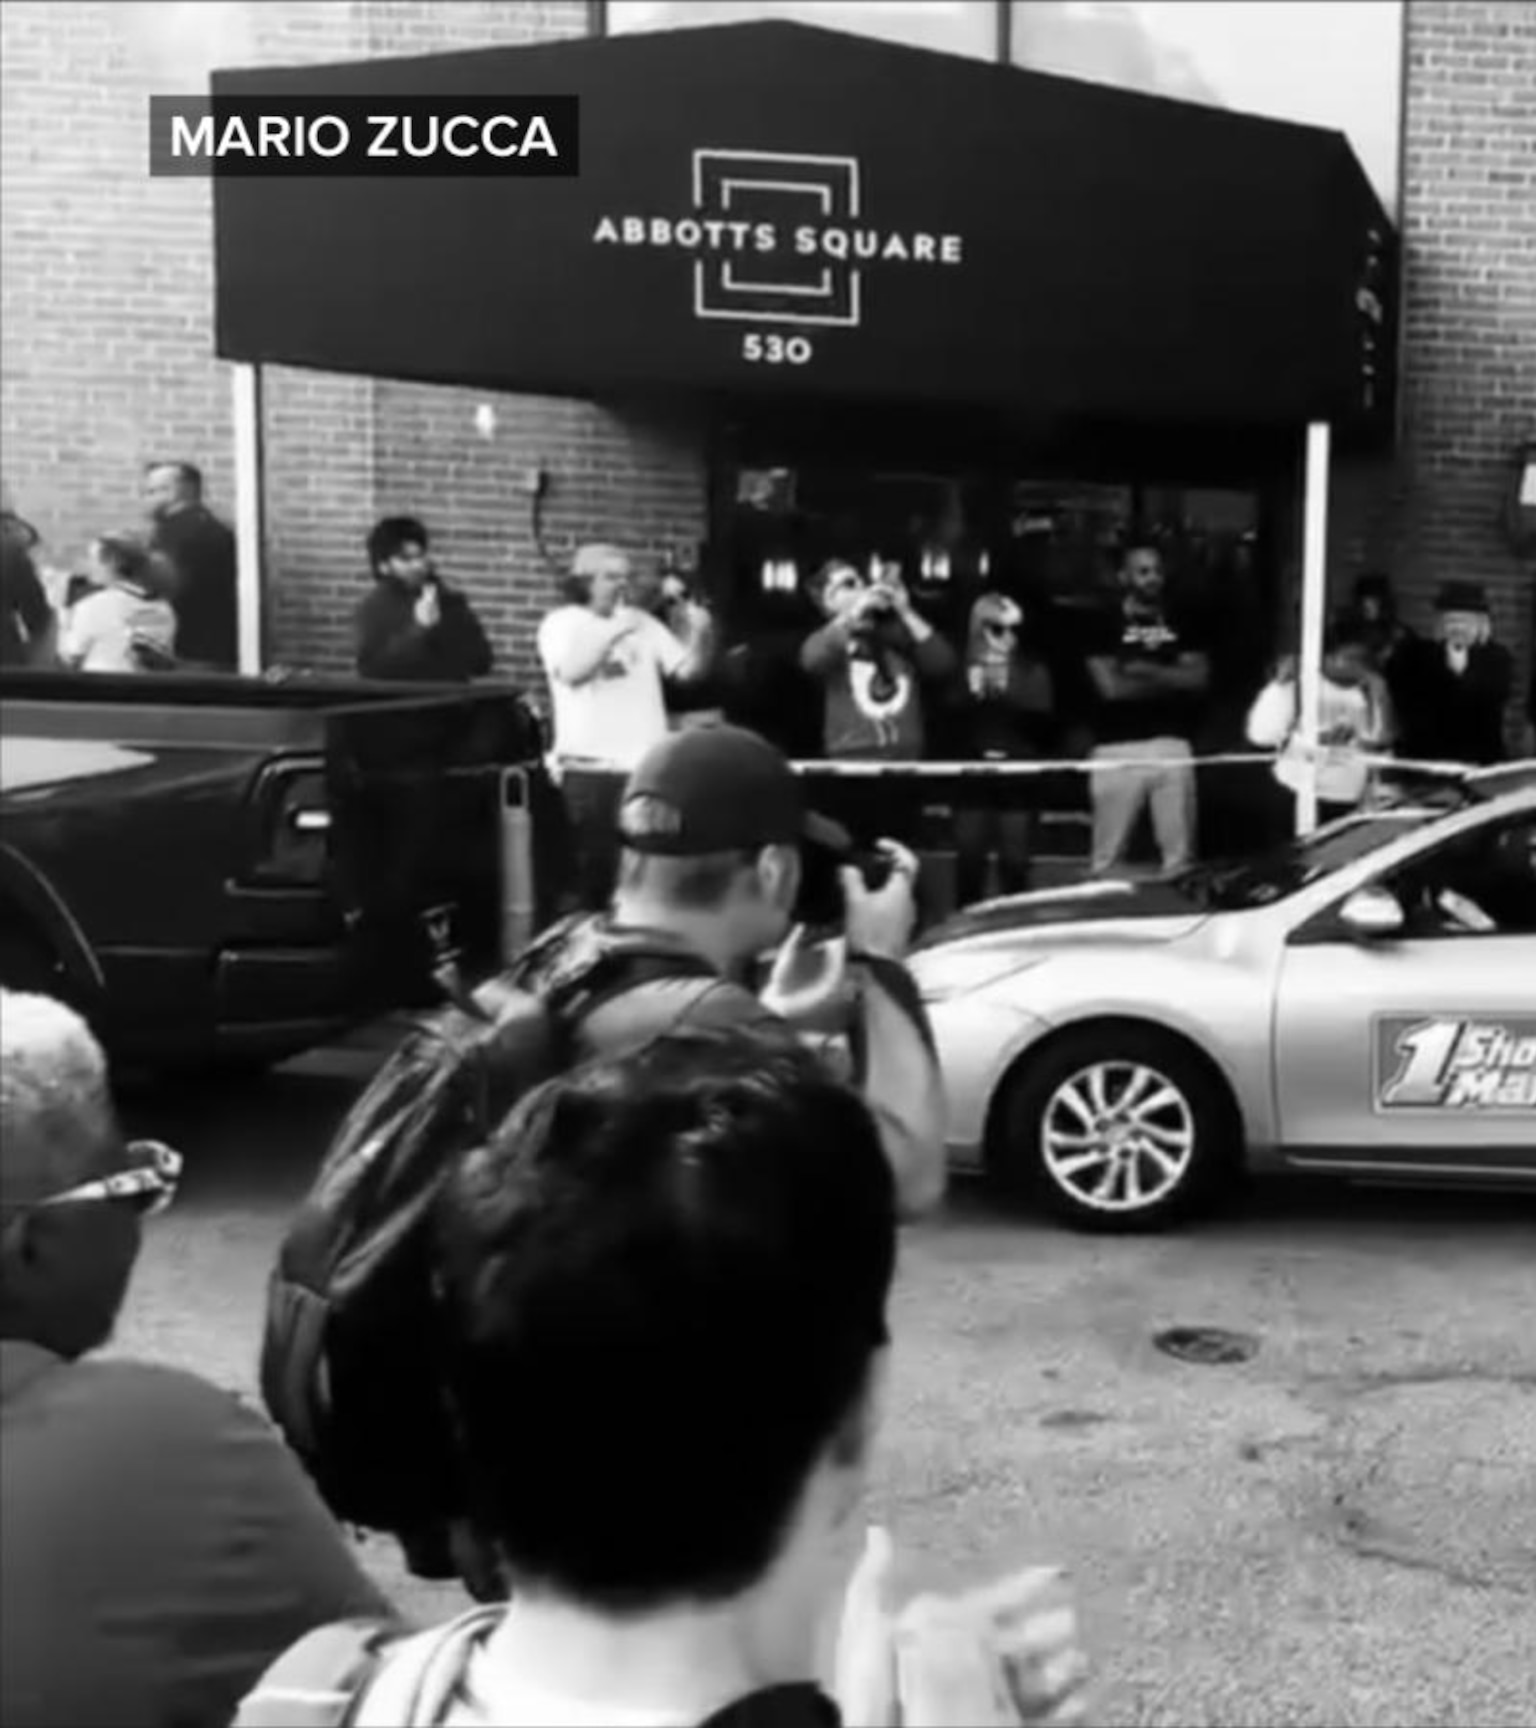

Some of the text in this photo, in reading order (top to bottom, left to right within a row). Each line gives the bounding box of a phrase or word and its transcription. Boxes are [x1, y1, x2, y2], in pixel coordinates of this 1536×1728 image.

[593, 216, 963, 263] ABBOTTS SQUARE
[742, 333, 813, 364] 530
[1385, 1021, 1463, 1105] 1
